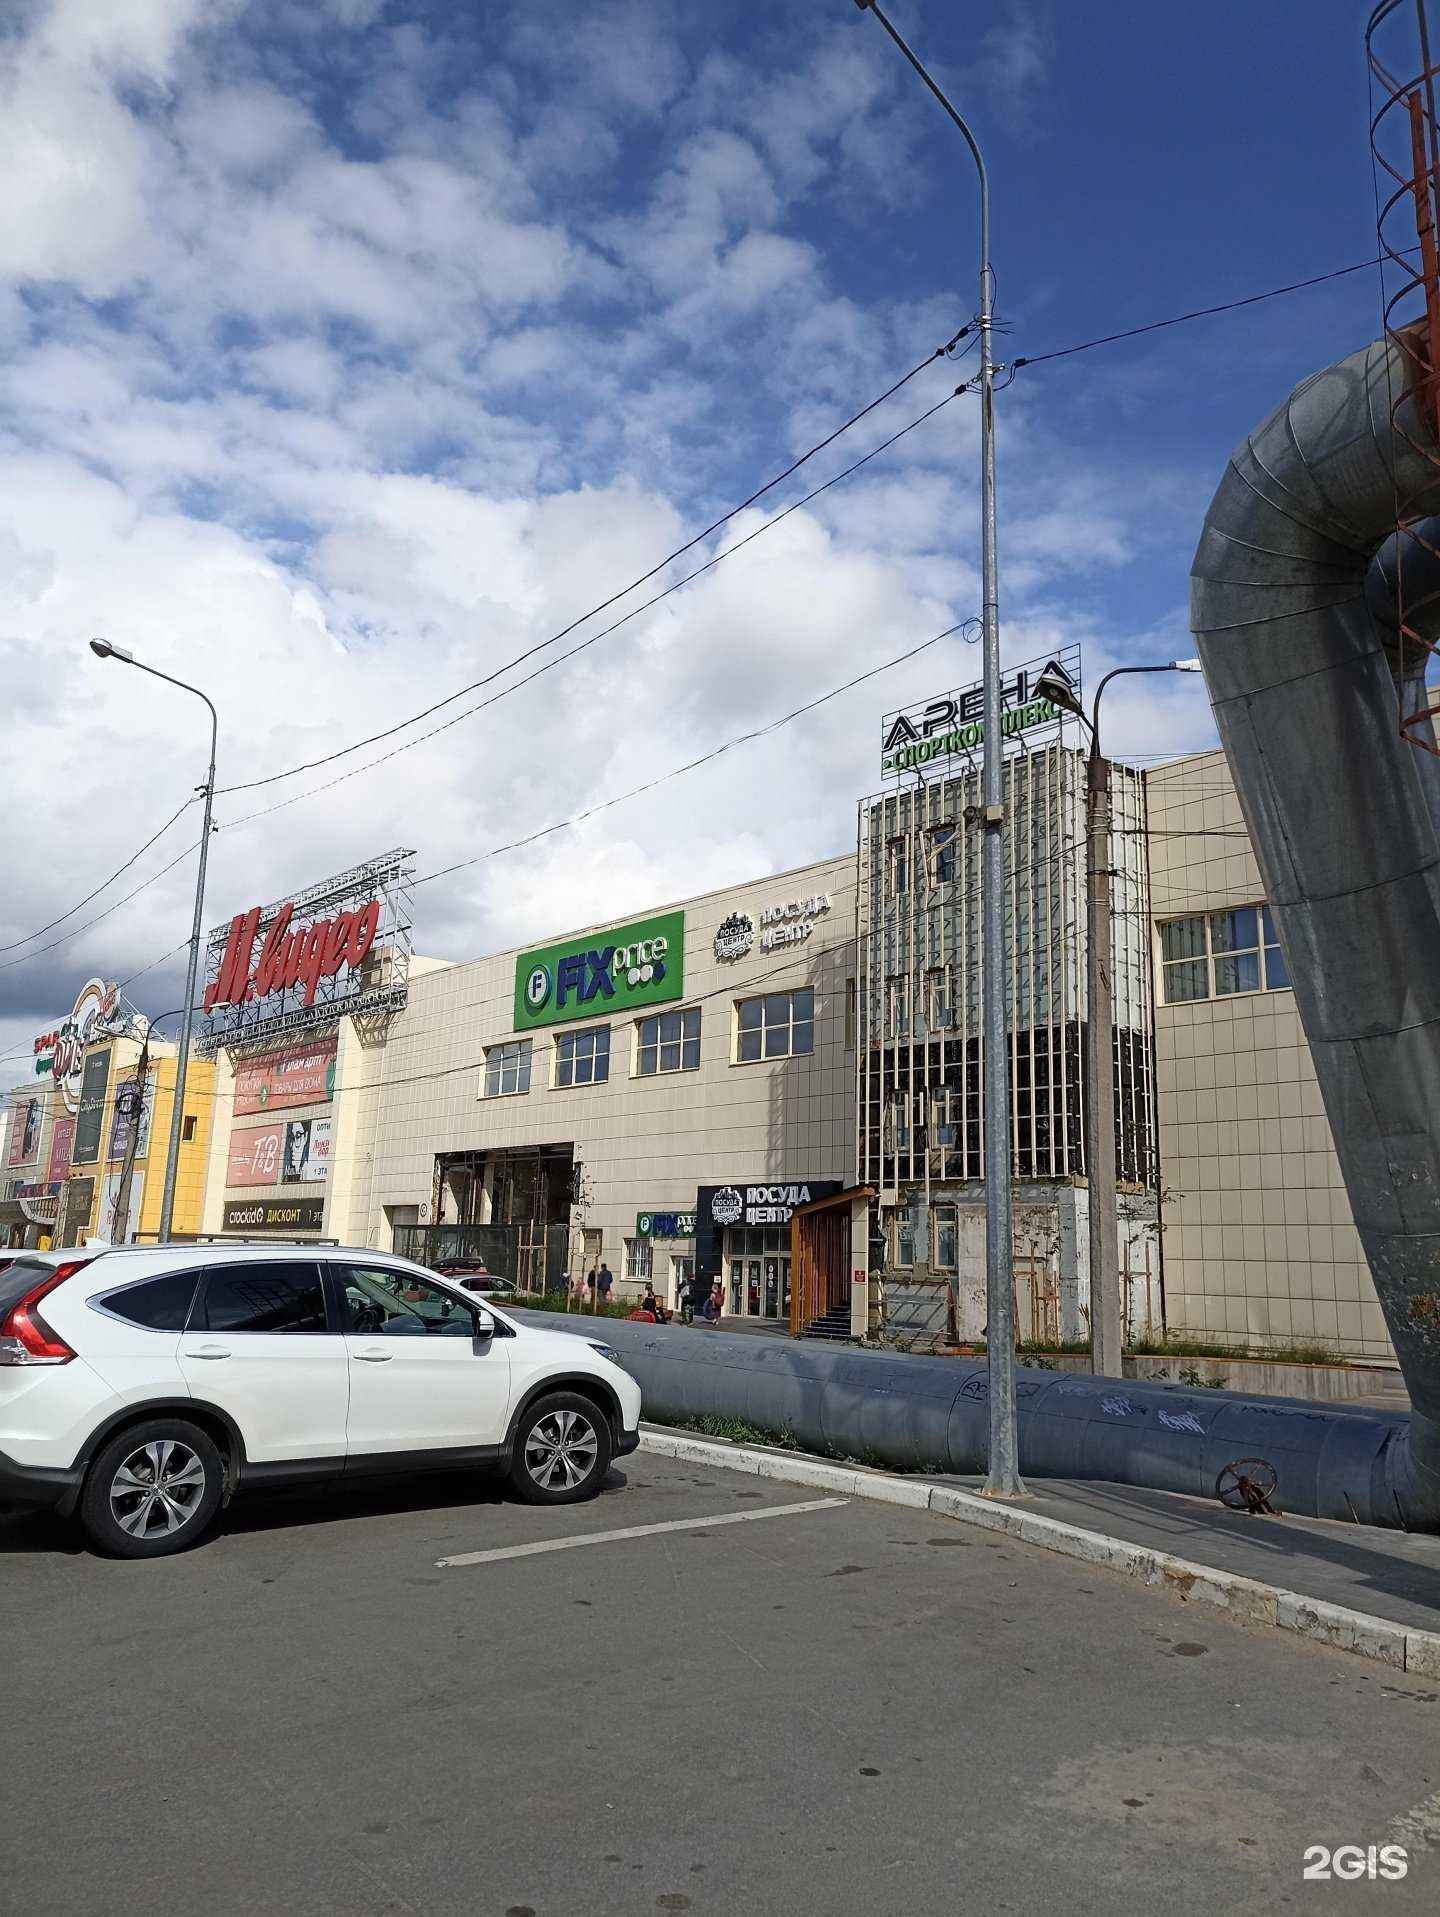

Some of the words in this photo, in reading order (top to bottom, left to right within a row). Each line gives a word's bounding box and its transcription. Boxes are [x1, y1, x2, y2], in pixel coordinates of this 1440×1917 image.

[893, 695, 1064, 770] СПОРТКОПЛЕКС
[612, 937, 667, 976] price
[746, 1185, 811, 1206] ПОСУДА
[746, 1205, 793, 1226] ЦЕНТР
